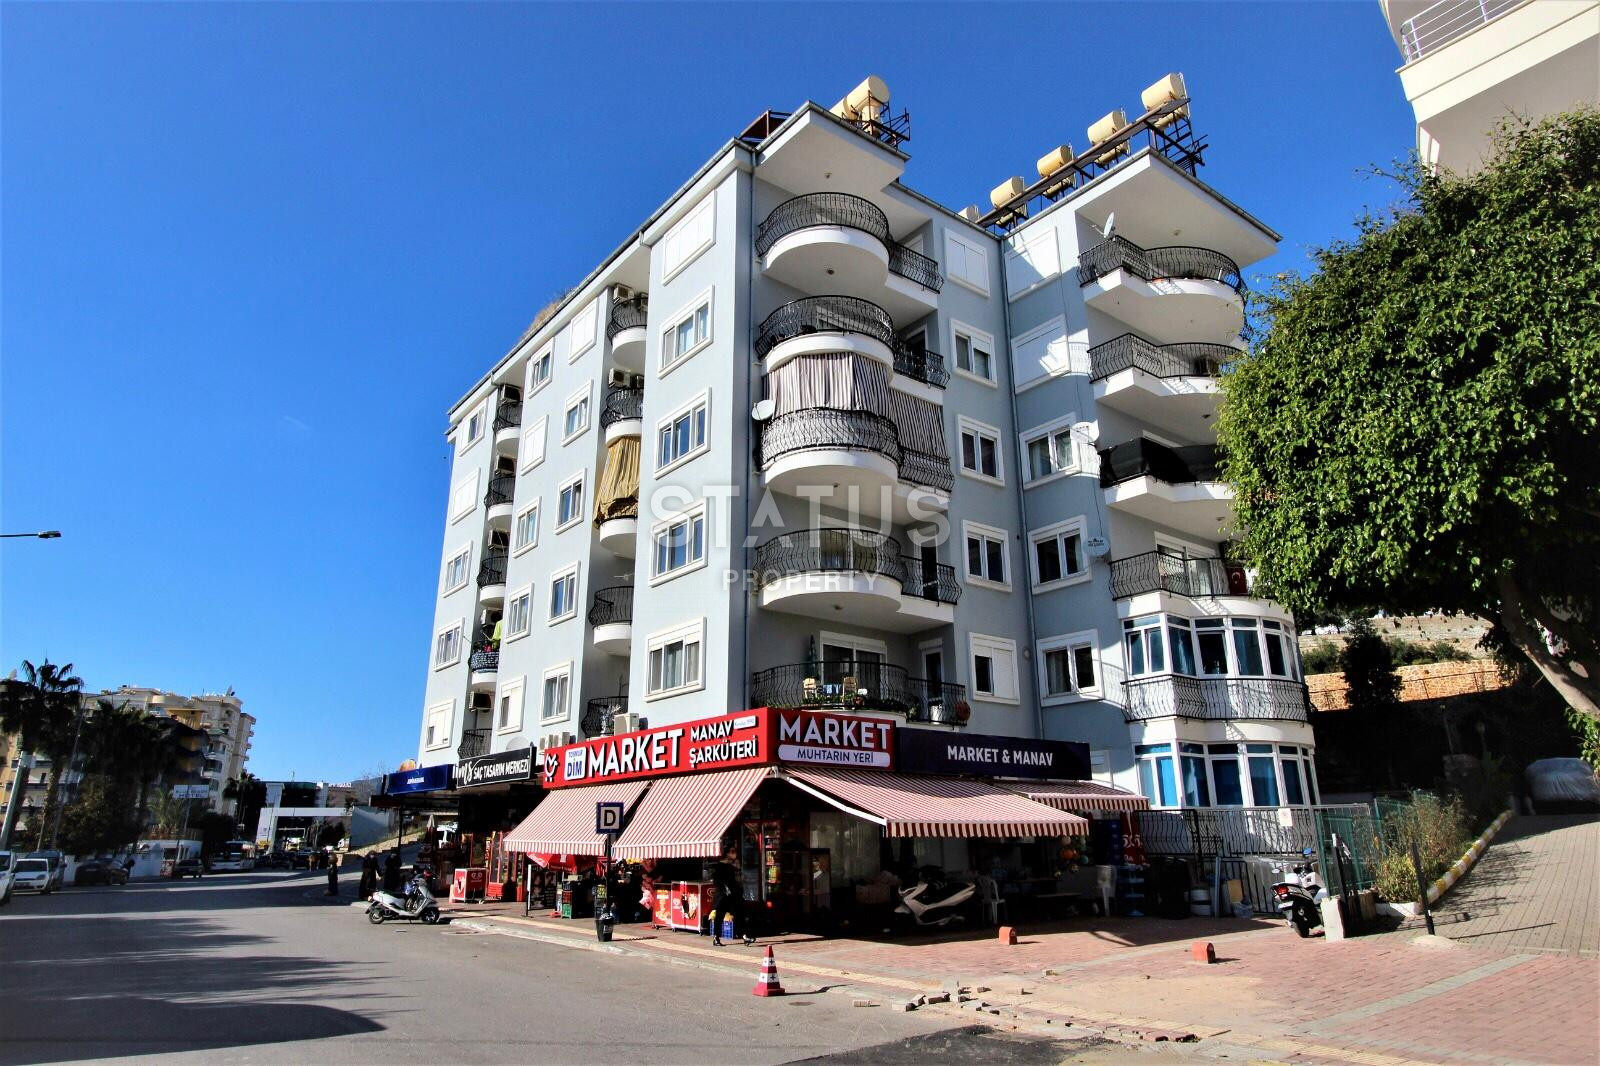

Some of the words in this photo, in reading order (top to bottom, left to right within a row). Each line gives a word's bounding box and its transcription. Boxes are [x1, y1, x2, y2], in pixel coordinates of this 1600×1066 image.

[691, 720, 733, 742] MANAV
[779, 713, 891, 749] MARKET
[588, 728, 685, 778] MARKET
[689, 735, 757, 768] ŞARKÜTERİ
[797, 748, 850, 763] MUHTARIN
[853, 751, 874, 764] YERİ
[947, 745, 999, 763] MARKET
[1002, 749, 1011, 764] &
[1013, 750, 1053, 767] MANAV
[483, 762, 505, 779] TASARIM
[567, 758, 582, 778] DİM
[603, 809, 617, 827] D
